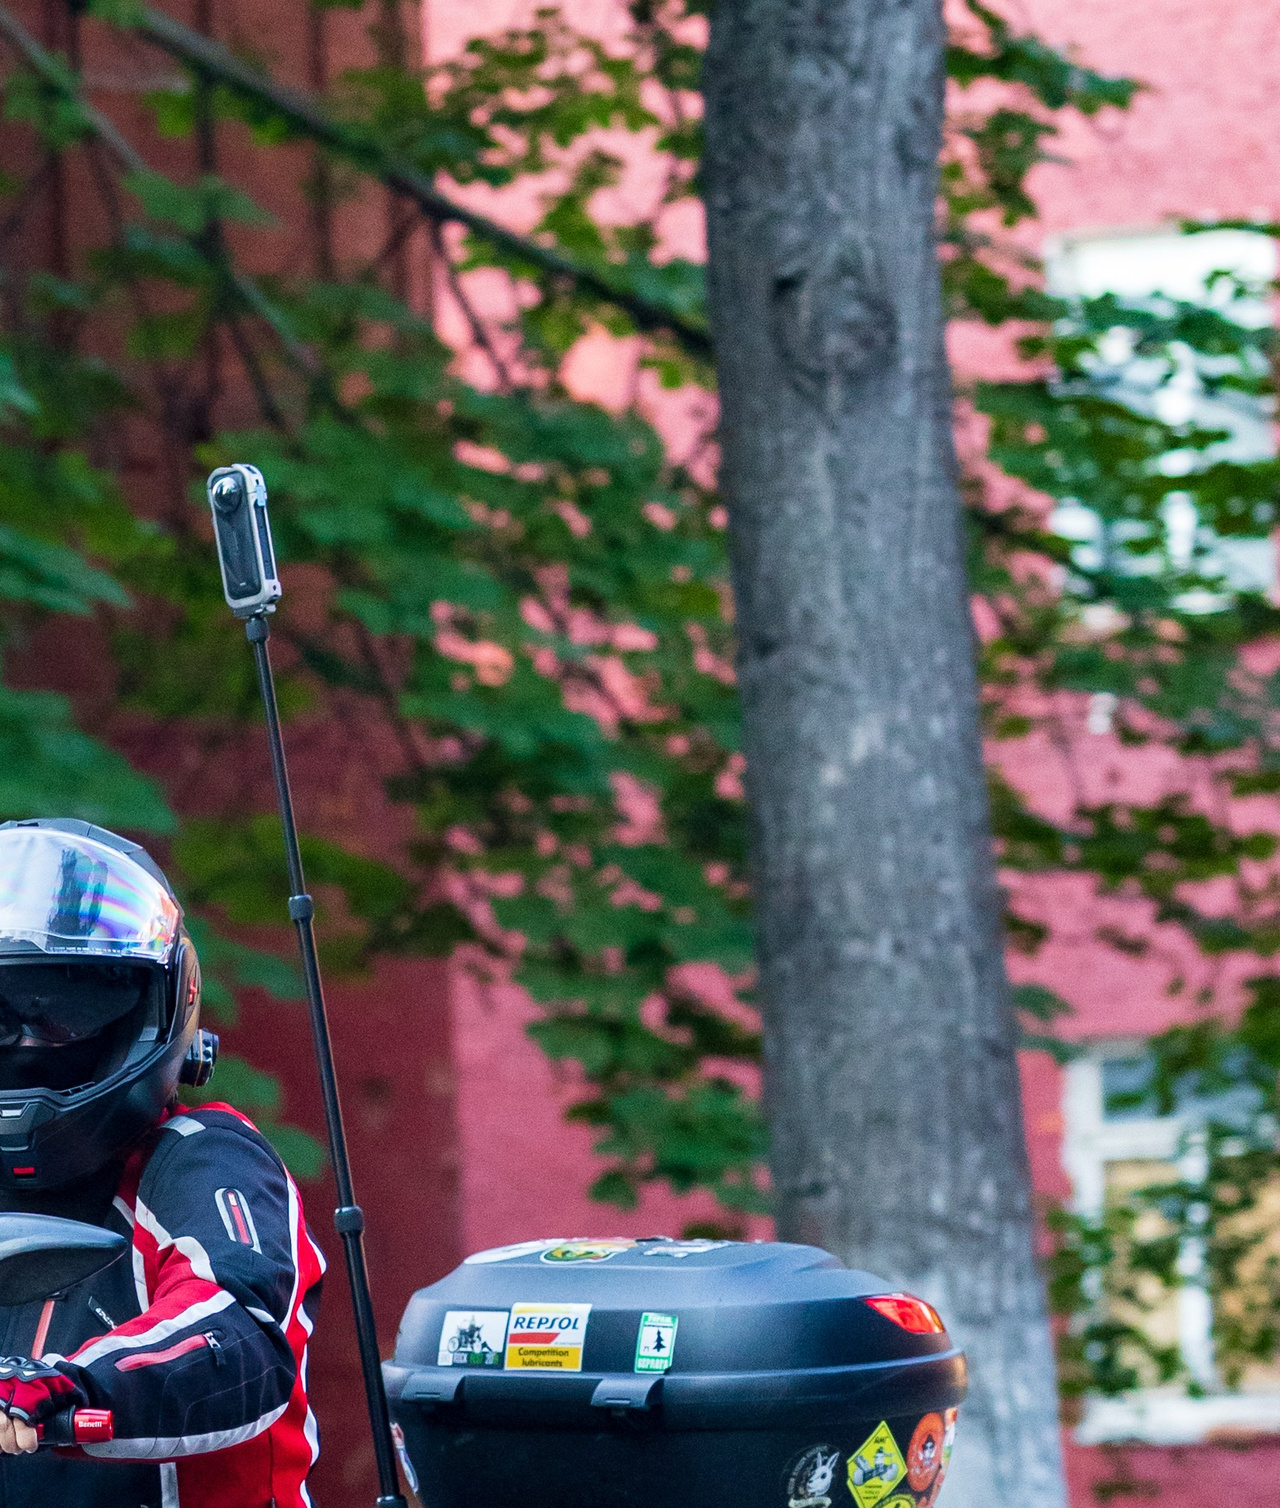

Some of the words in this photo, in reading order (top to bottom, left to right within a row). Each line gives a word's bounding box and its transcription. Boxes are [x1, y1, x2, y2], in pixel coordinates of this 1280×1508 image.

[513, 1316, 579, 1330] REPSOL
[517, 1347, 569, 1358] Competition
[521, 1356, 563, 1368] lubricants
[78, 1420, 102, 1428] Benelli
